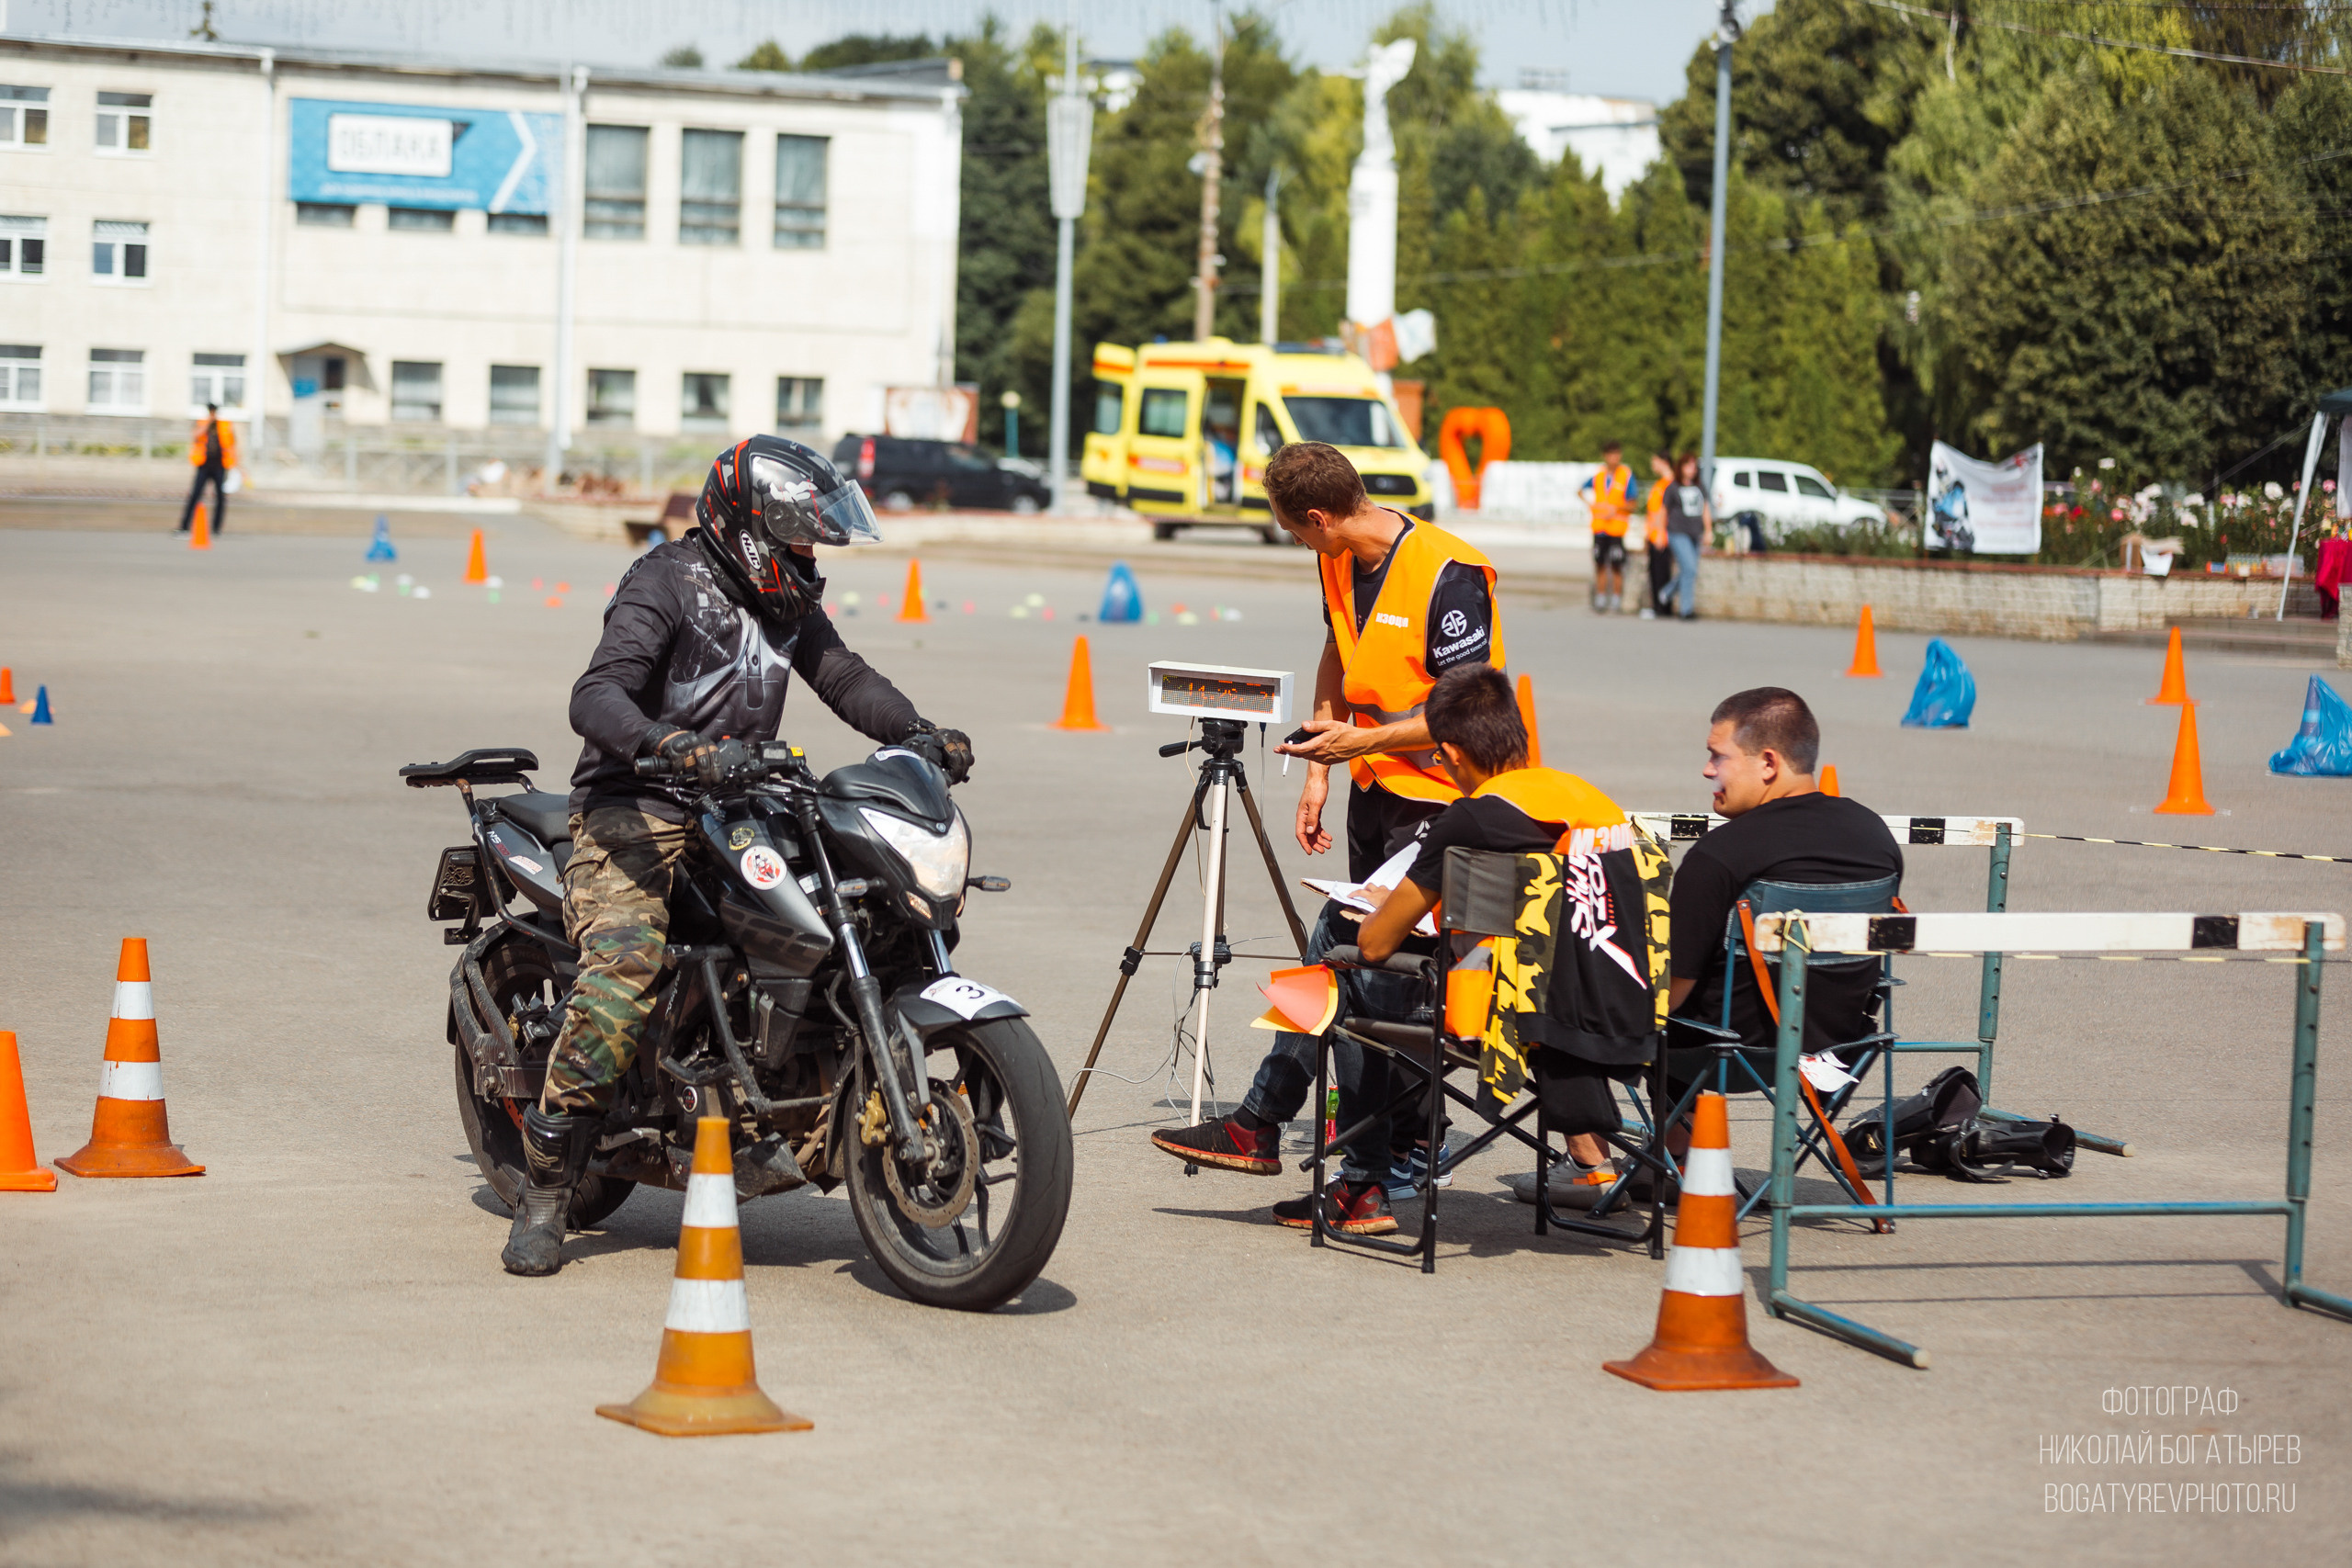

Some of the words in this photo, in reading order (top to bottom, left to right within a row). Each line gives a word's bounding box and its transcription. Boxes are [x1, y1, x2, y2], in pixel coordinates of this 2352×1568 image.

[742, 537, 761, 566] HJC
[1433, 626, 1486, 659] Kawasaki
[1455, 649, 1471, 660] good
[956, 985, 986, 999] 3
